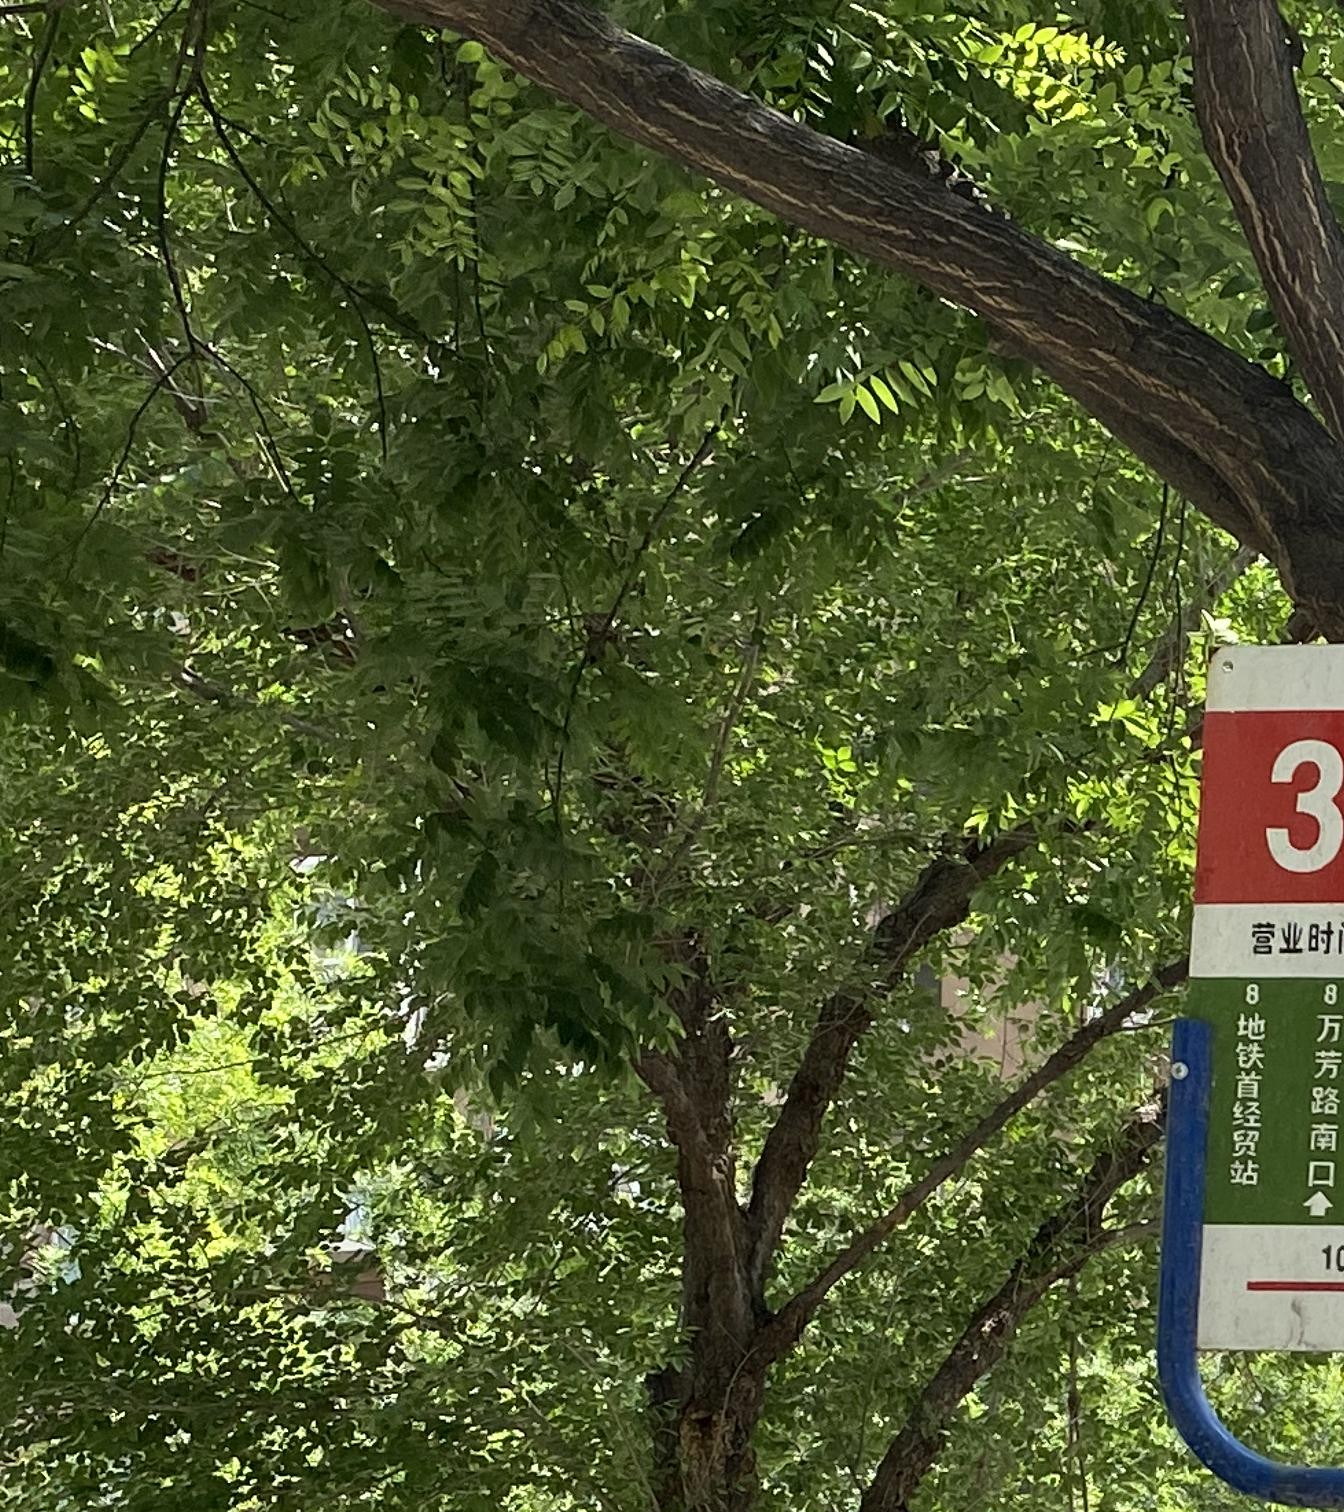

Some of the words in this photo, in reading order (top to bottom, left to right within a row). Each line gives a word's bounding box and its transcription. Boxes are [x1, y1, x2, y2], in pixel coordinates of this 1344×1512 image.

[1246, 984, 1259, 1004] 8
[1324, 984, 1338, 1004] 8
[1230, 1012, 1266, 1185] 地铁首经贸站
[1308, 1014, 1344, 1187] 万芳路南口
